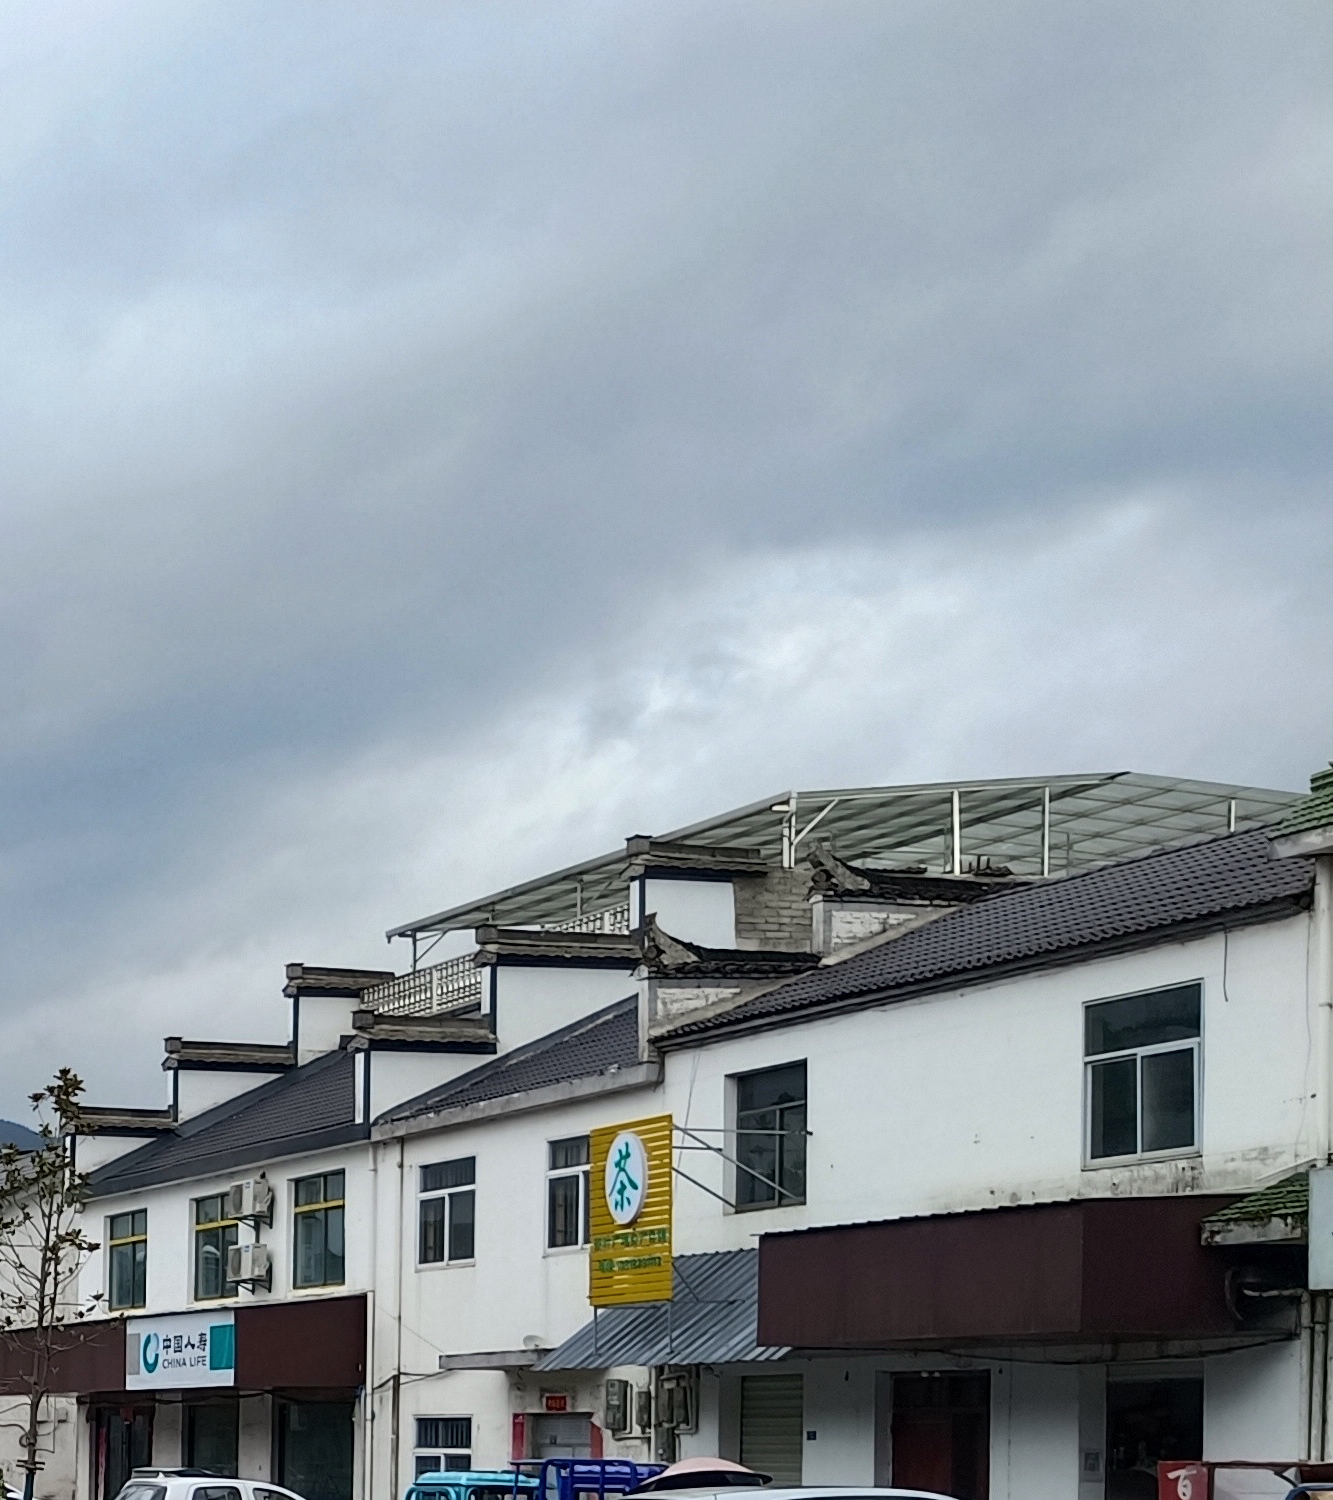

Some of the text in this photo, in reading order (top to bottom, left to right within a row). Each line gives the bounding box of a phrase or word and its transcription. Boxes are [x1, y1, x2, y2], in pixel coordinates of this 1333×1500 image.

[608, 1141, 639, 1213] 茶
[162, 1332, 207, 1355] 中国人寿
[162, 1355, 207, 1370] CHINA LIFE
